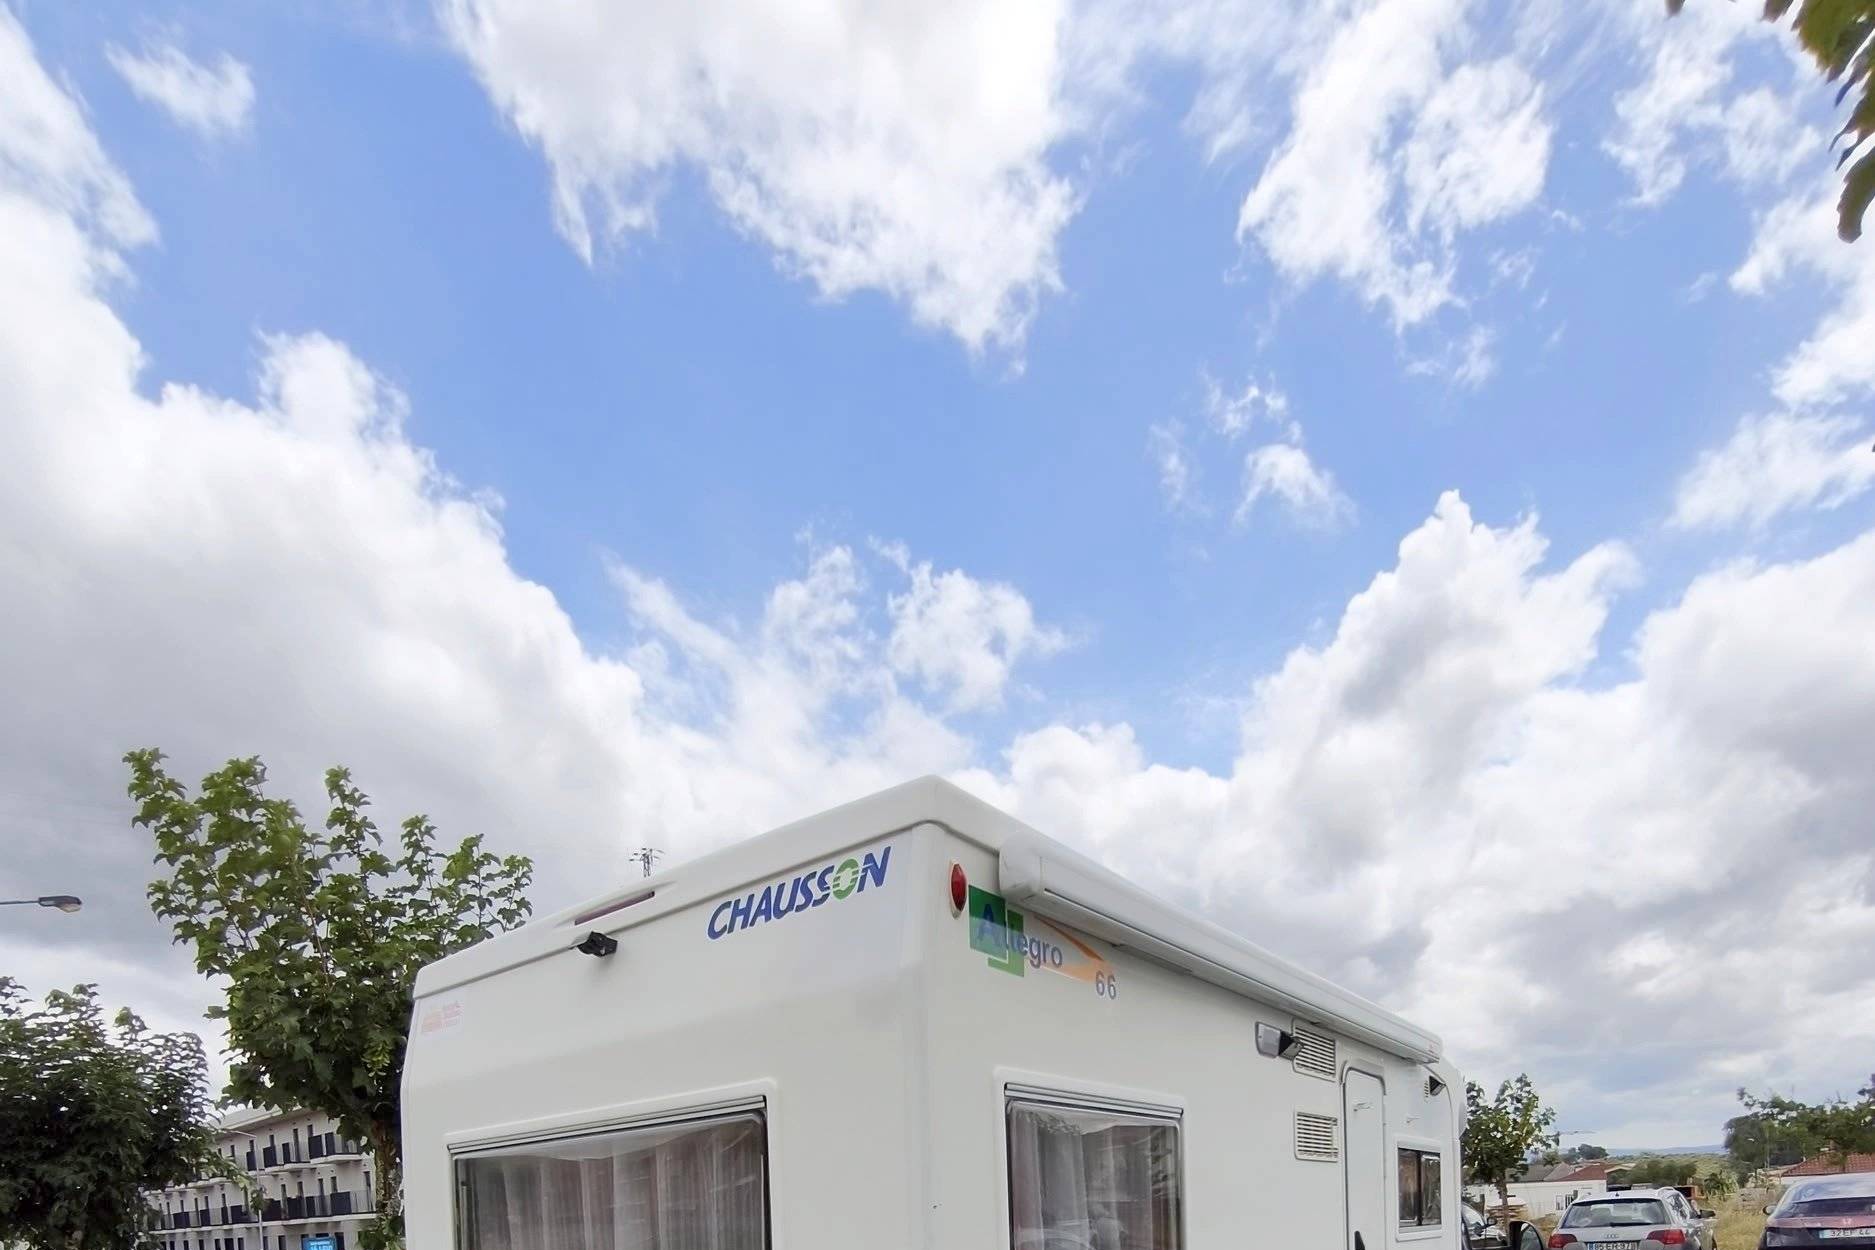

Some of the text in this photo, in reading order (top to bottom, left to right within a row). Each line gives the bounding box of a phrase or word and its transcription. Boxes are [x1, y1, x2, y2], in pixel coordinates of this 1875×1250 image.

[707, 845, 892, 940] CHAUSSON
[977, 903, 1063, 969] Allegro
[1095, 970, 1117, 1000] 66
